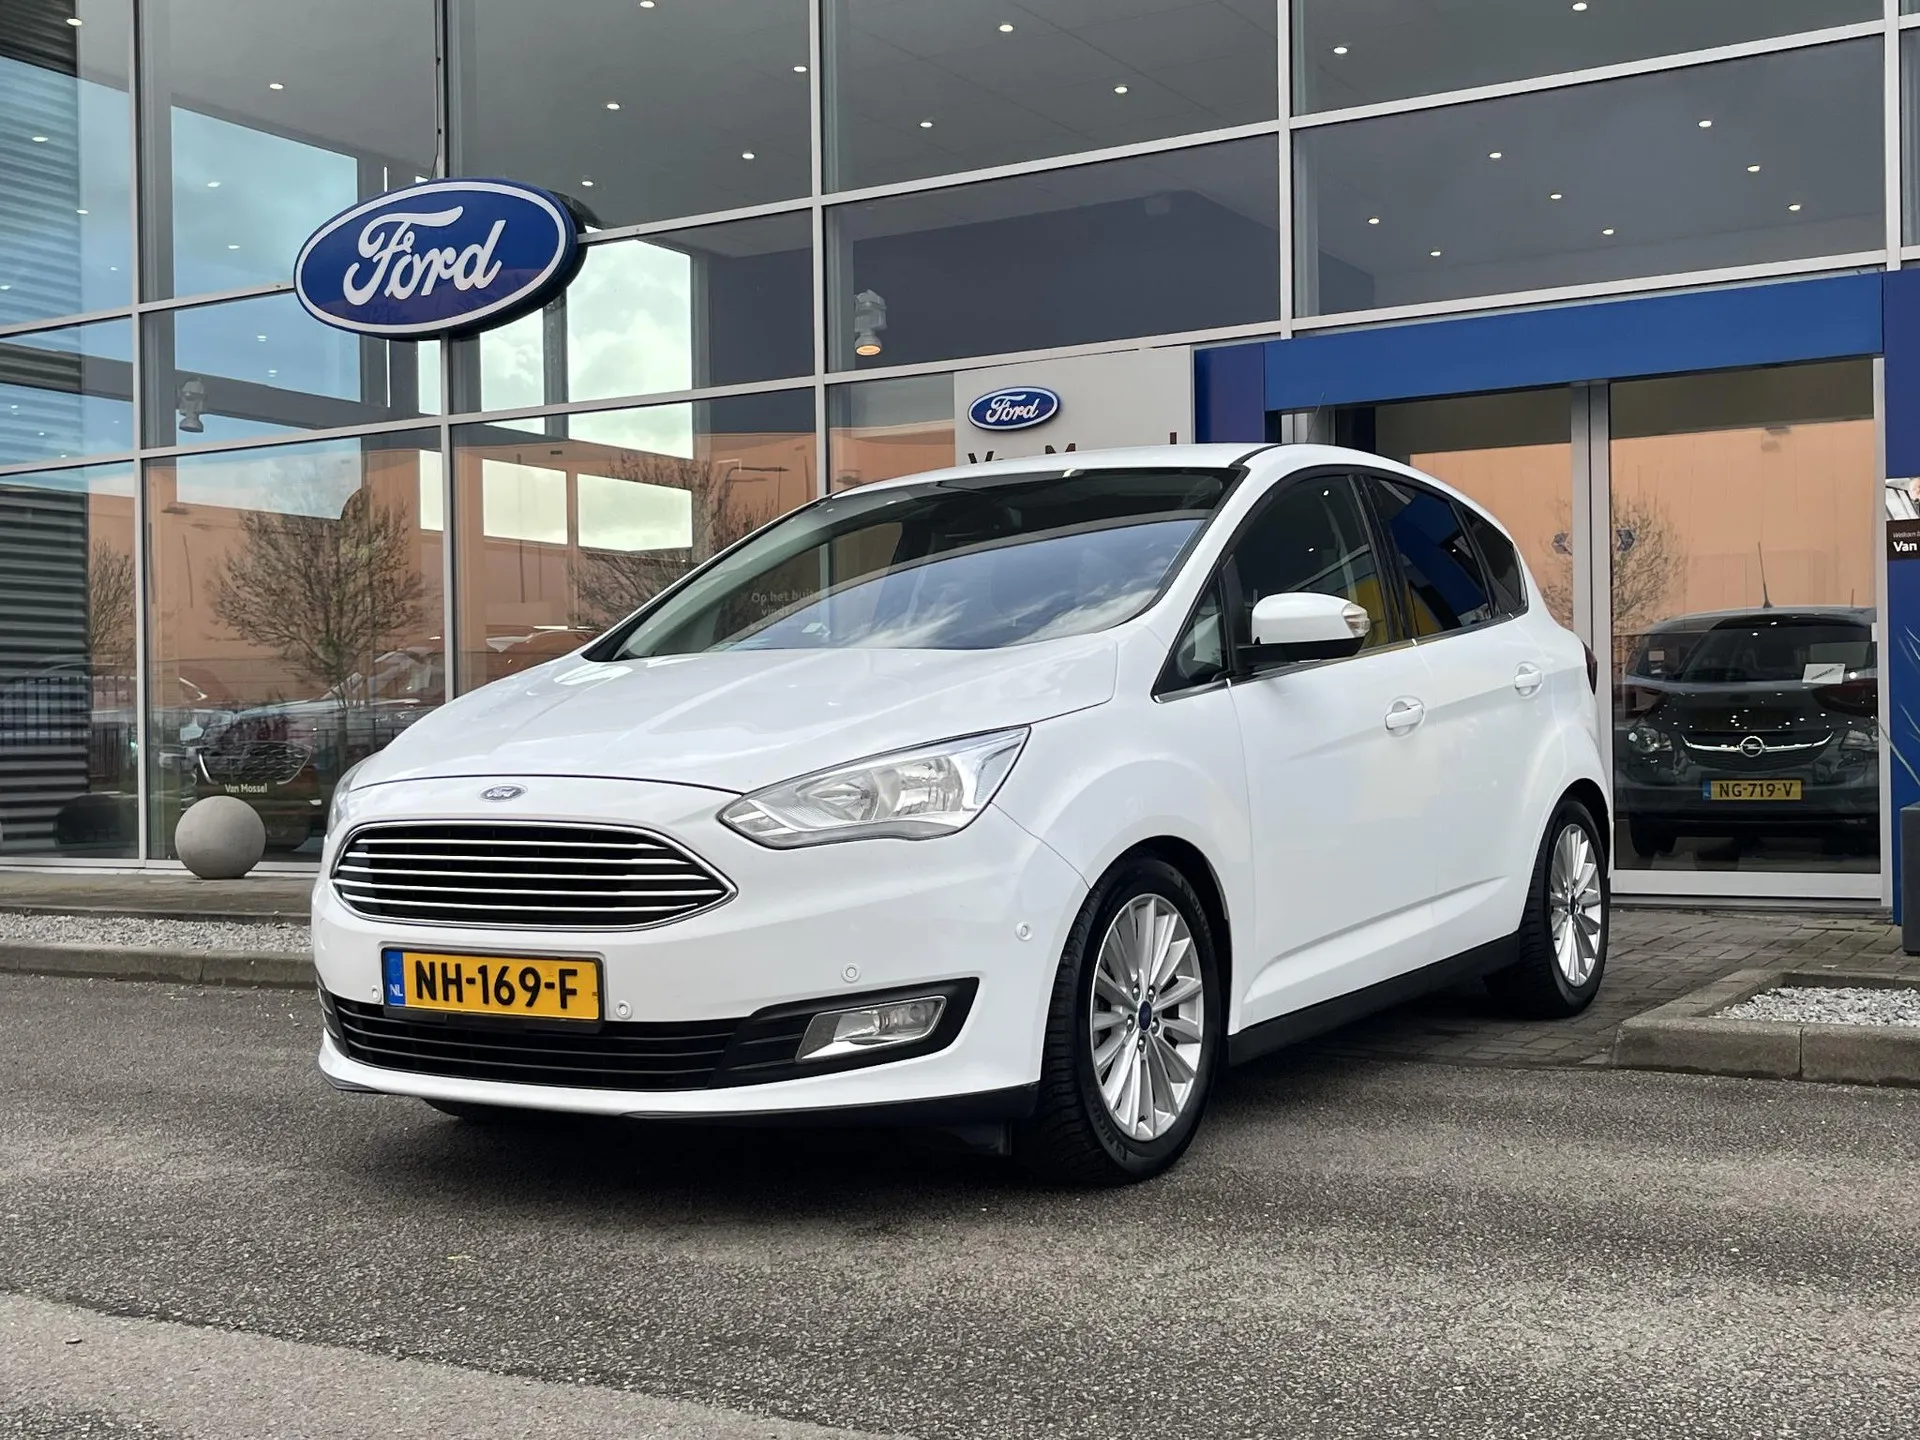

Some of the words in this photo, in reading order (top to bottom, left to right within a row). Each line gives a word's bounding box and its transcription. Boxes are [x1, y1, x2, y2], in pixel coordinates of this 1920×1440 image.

[343, 206, 507, 306] Ford
[985, 394, 1041, 423] Ford
[1893, 541, 1918, 552] Van
[224, 783, 240, 793] Van
[240, 782, 268, 793] Mossel
[1719, 782, 1794, 798] NG-719-V
[390, 984, 404, 997] NL
[415, 959, 578, 1010] NH-169-F
